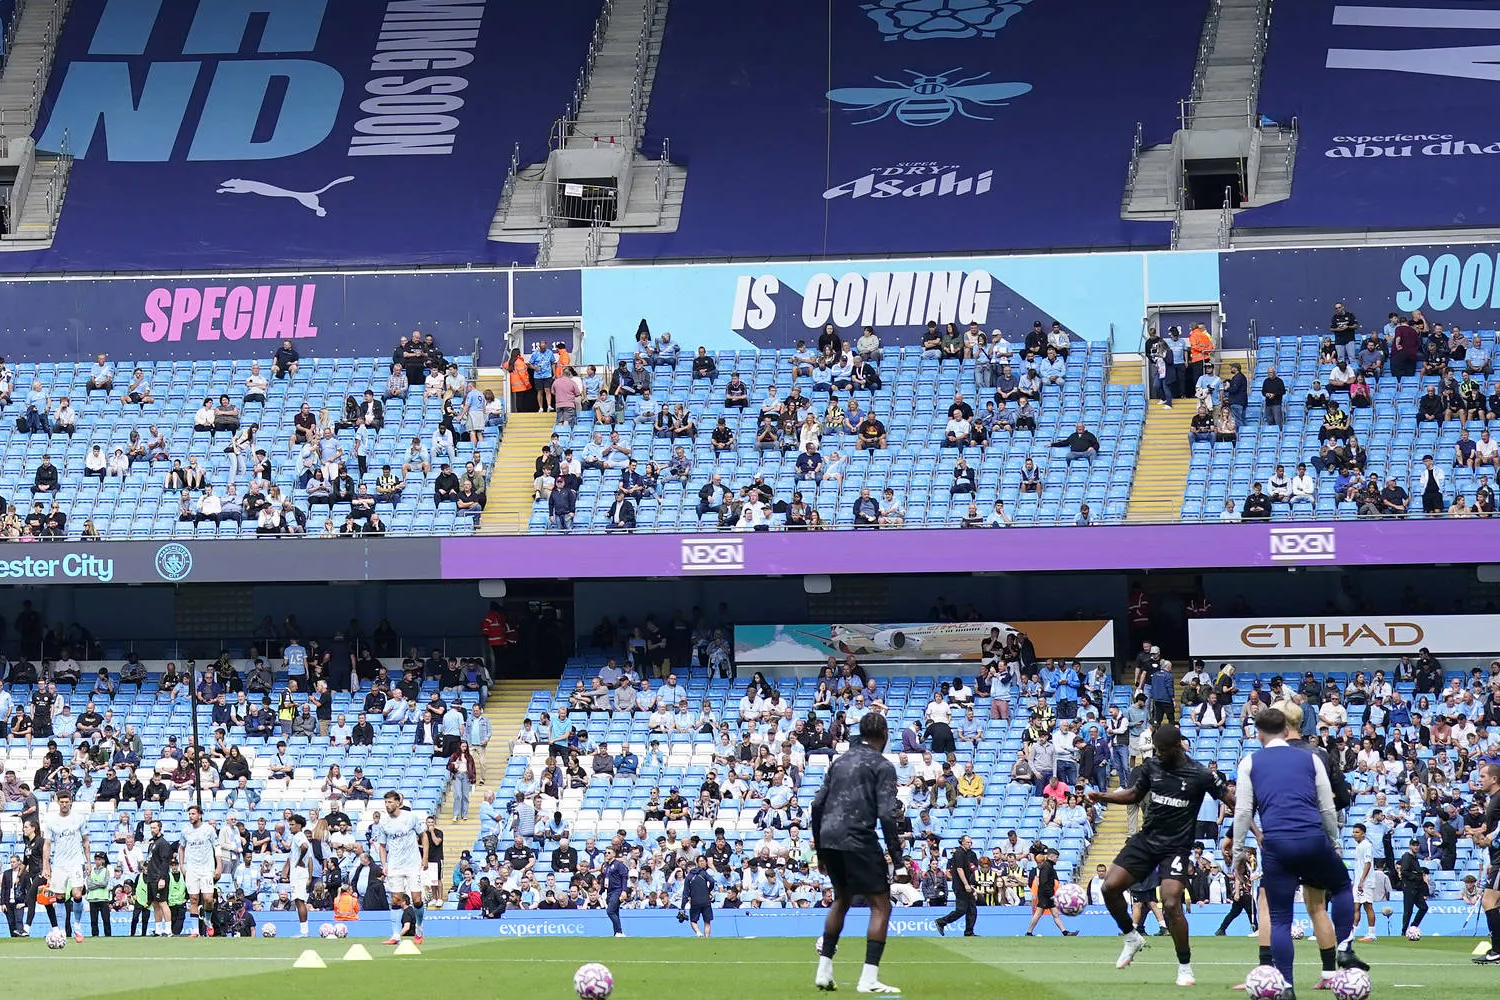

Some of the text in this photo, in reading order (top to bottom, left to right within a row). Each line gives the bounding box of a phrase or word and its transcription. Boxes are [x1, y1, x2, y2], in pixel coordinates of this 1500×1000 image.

[348, 76, 468, 157] SOON
[1324, 143, 1412, 158] abu
[1332, 133, 1453, 144] experience
[822, 169, 993, 199] Asahi
[1396, 252, 1500, 312] SOO
[731, 268, 992, 330] IS COMING
[140, 283, 318, 342] SPECIAL
[681, 544, 744, 564] NEXEN
[1269, 534, 1336, 554] NEXEN
[62, 553, 114, 582] City
[1240, 622, 1424, 648] ETIHAD
[1171, 855, 1182, 872] 4
[499, 921, 585, 936] experience
